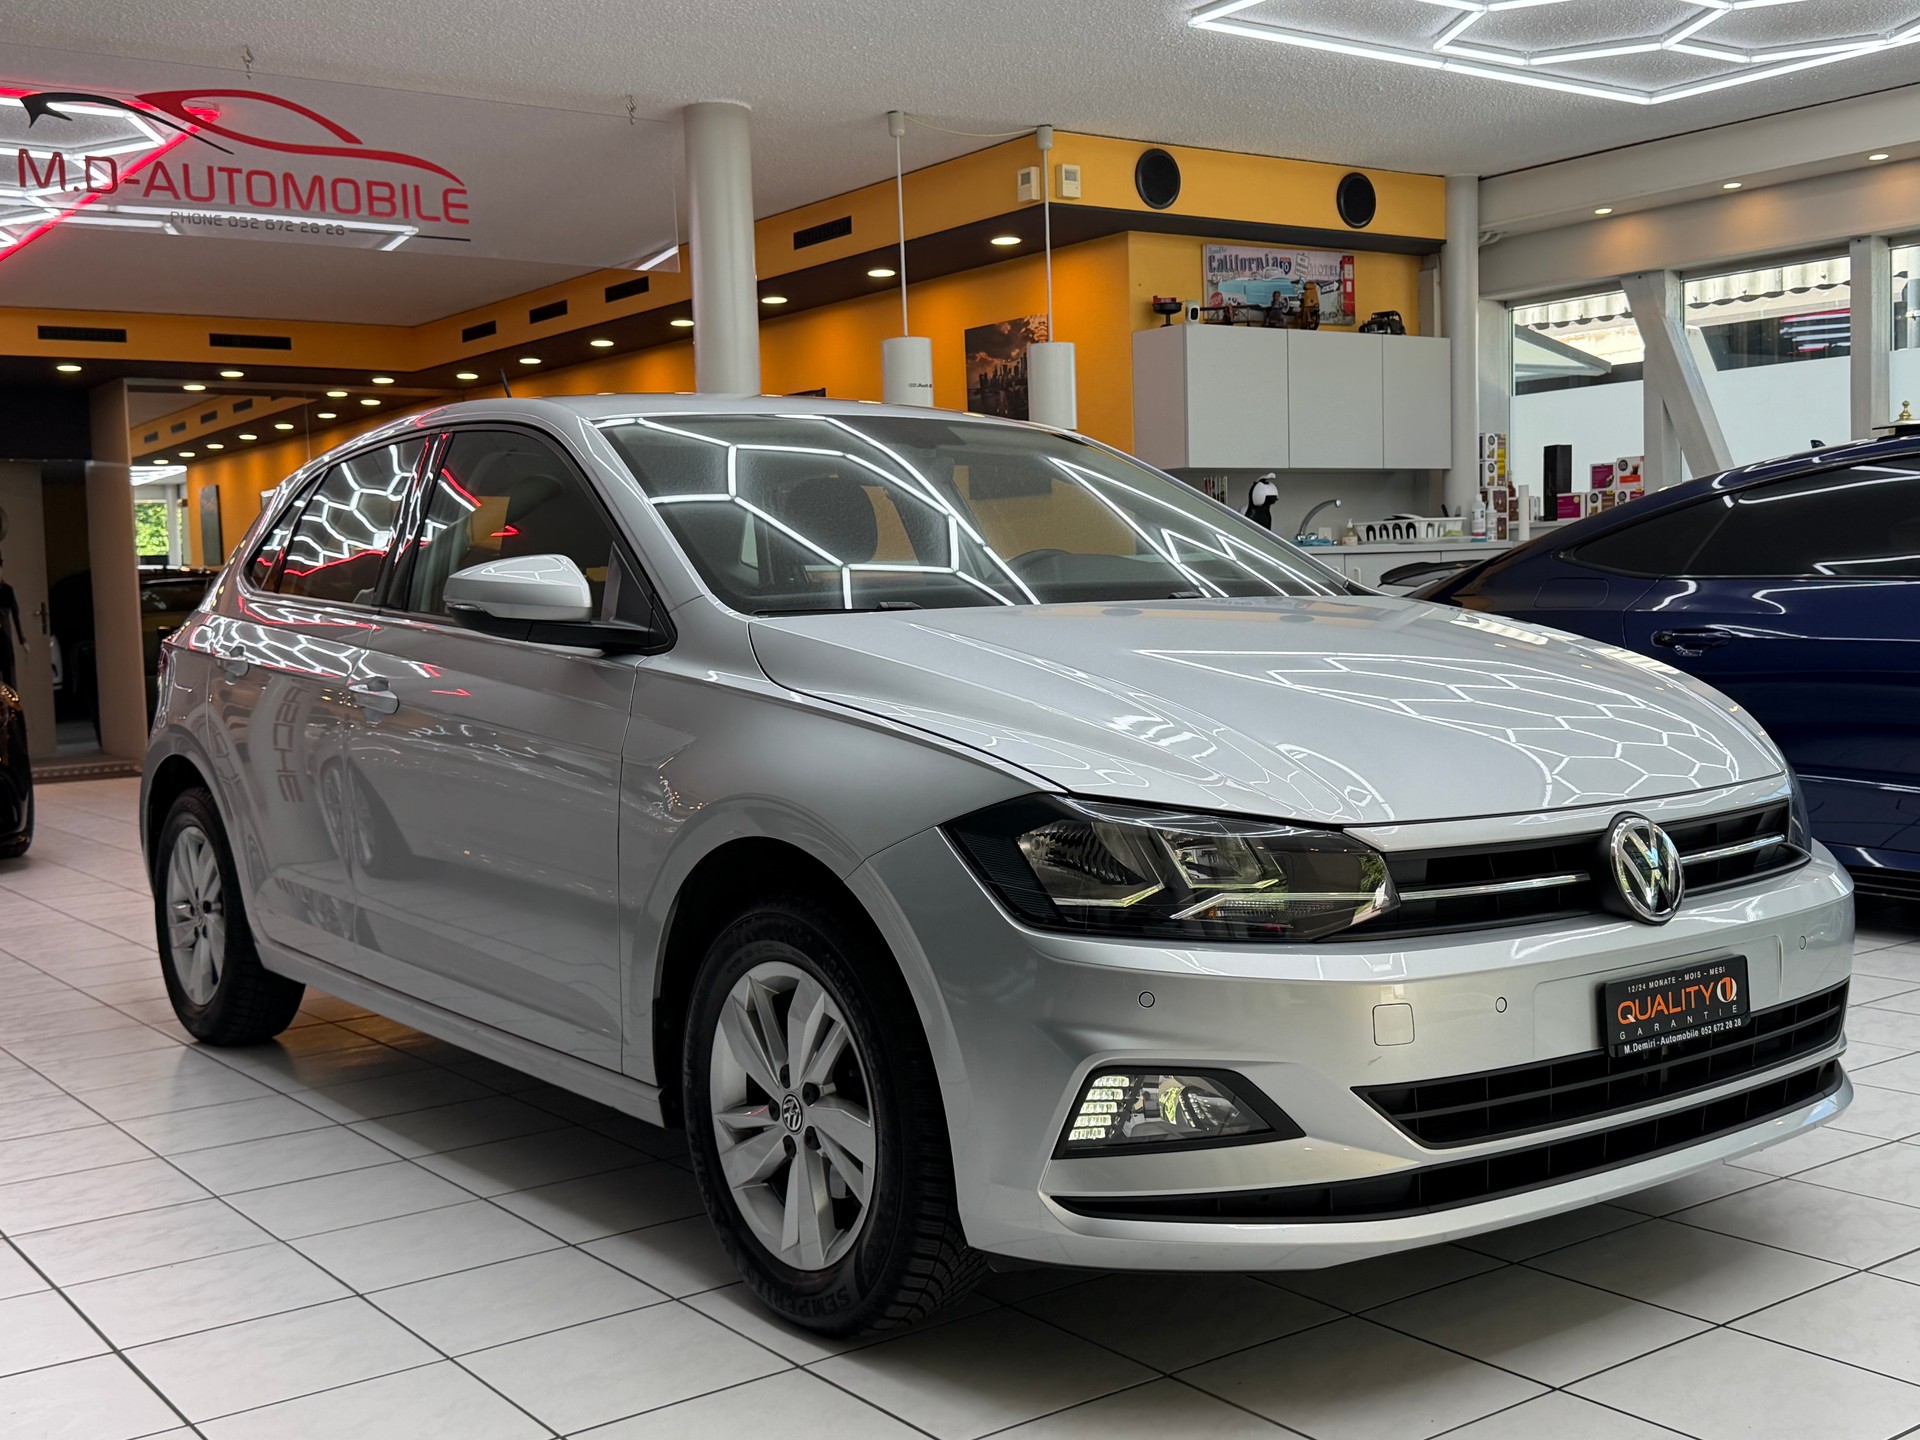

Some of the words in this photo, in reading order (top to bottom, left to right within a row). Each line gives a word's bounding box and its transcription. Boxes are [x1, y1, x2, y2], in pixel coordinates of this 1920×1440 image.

[18, 148, 470, 225] M.D-AUTOMOBILE
[170, 211, 224, 227] PHONE
[228, 216, 259, 230] 052
[265, 218, 294, 232] 672
[300, 221, 320, 234] 28
[326, 223, 345, 236] 28
[1208, 253, 1279, 274] California
[1627, 983, 1646, 994] 12/24
[1648, 976, 1676, 989] MONATE
[1684, 971, 1701, 981] MOIS
[1709, 965, 1726, 976] MESI
[1617, 981, 1715, 1025] QUALITY
[1619, 1005, 1738, 1040] GARANTIE
[1660, 1027, 1699, 1046] Automobile
[1700, 1025, 1712, 1036] 052
[1713, 1022, 1725, 1033] 672
[1725, 1020, 1733, 1030] 28
[1733, 1018, 1742, 1028] 28
